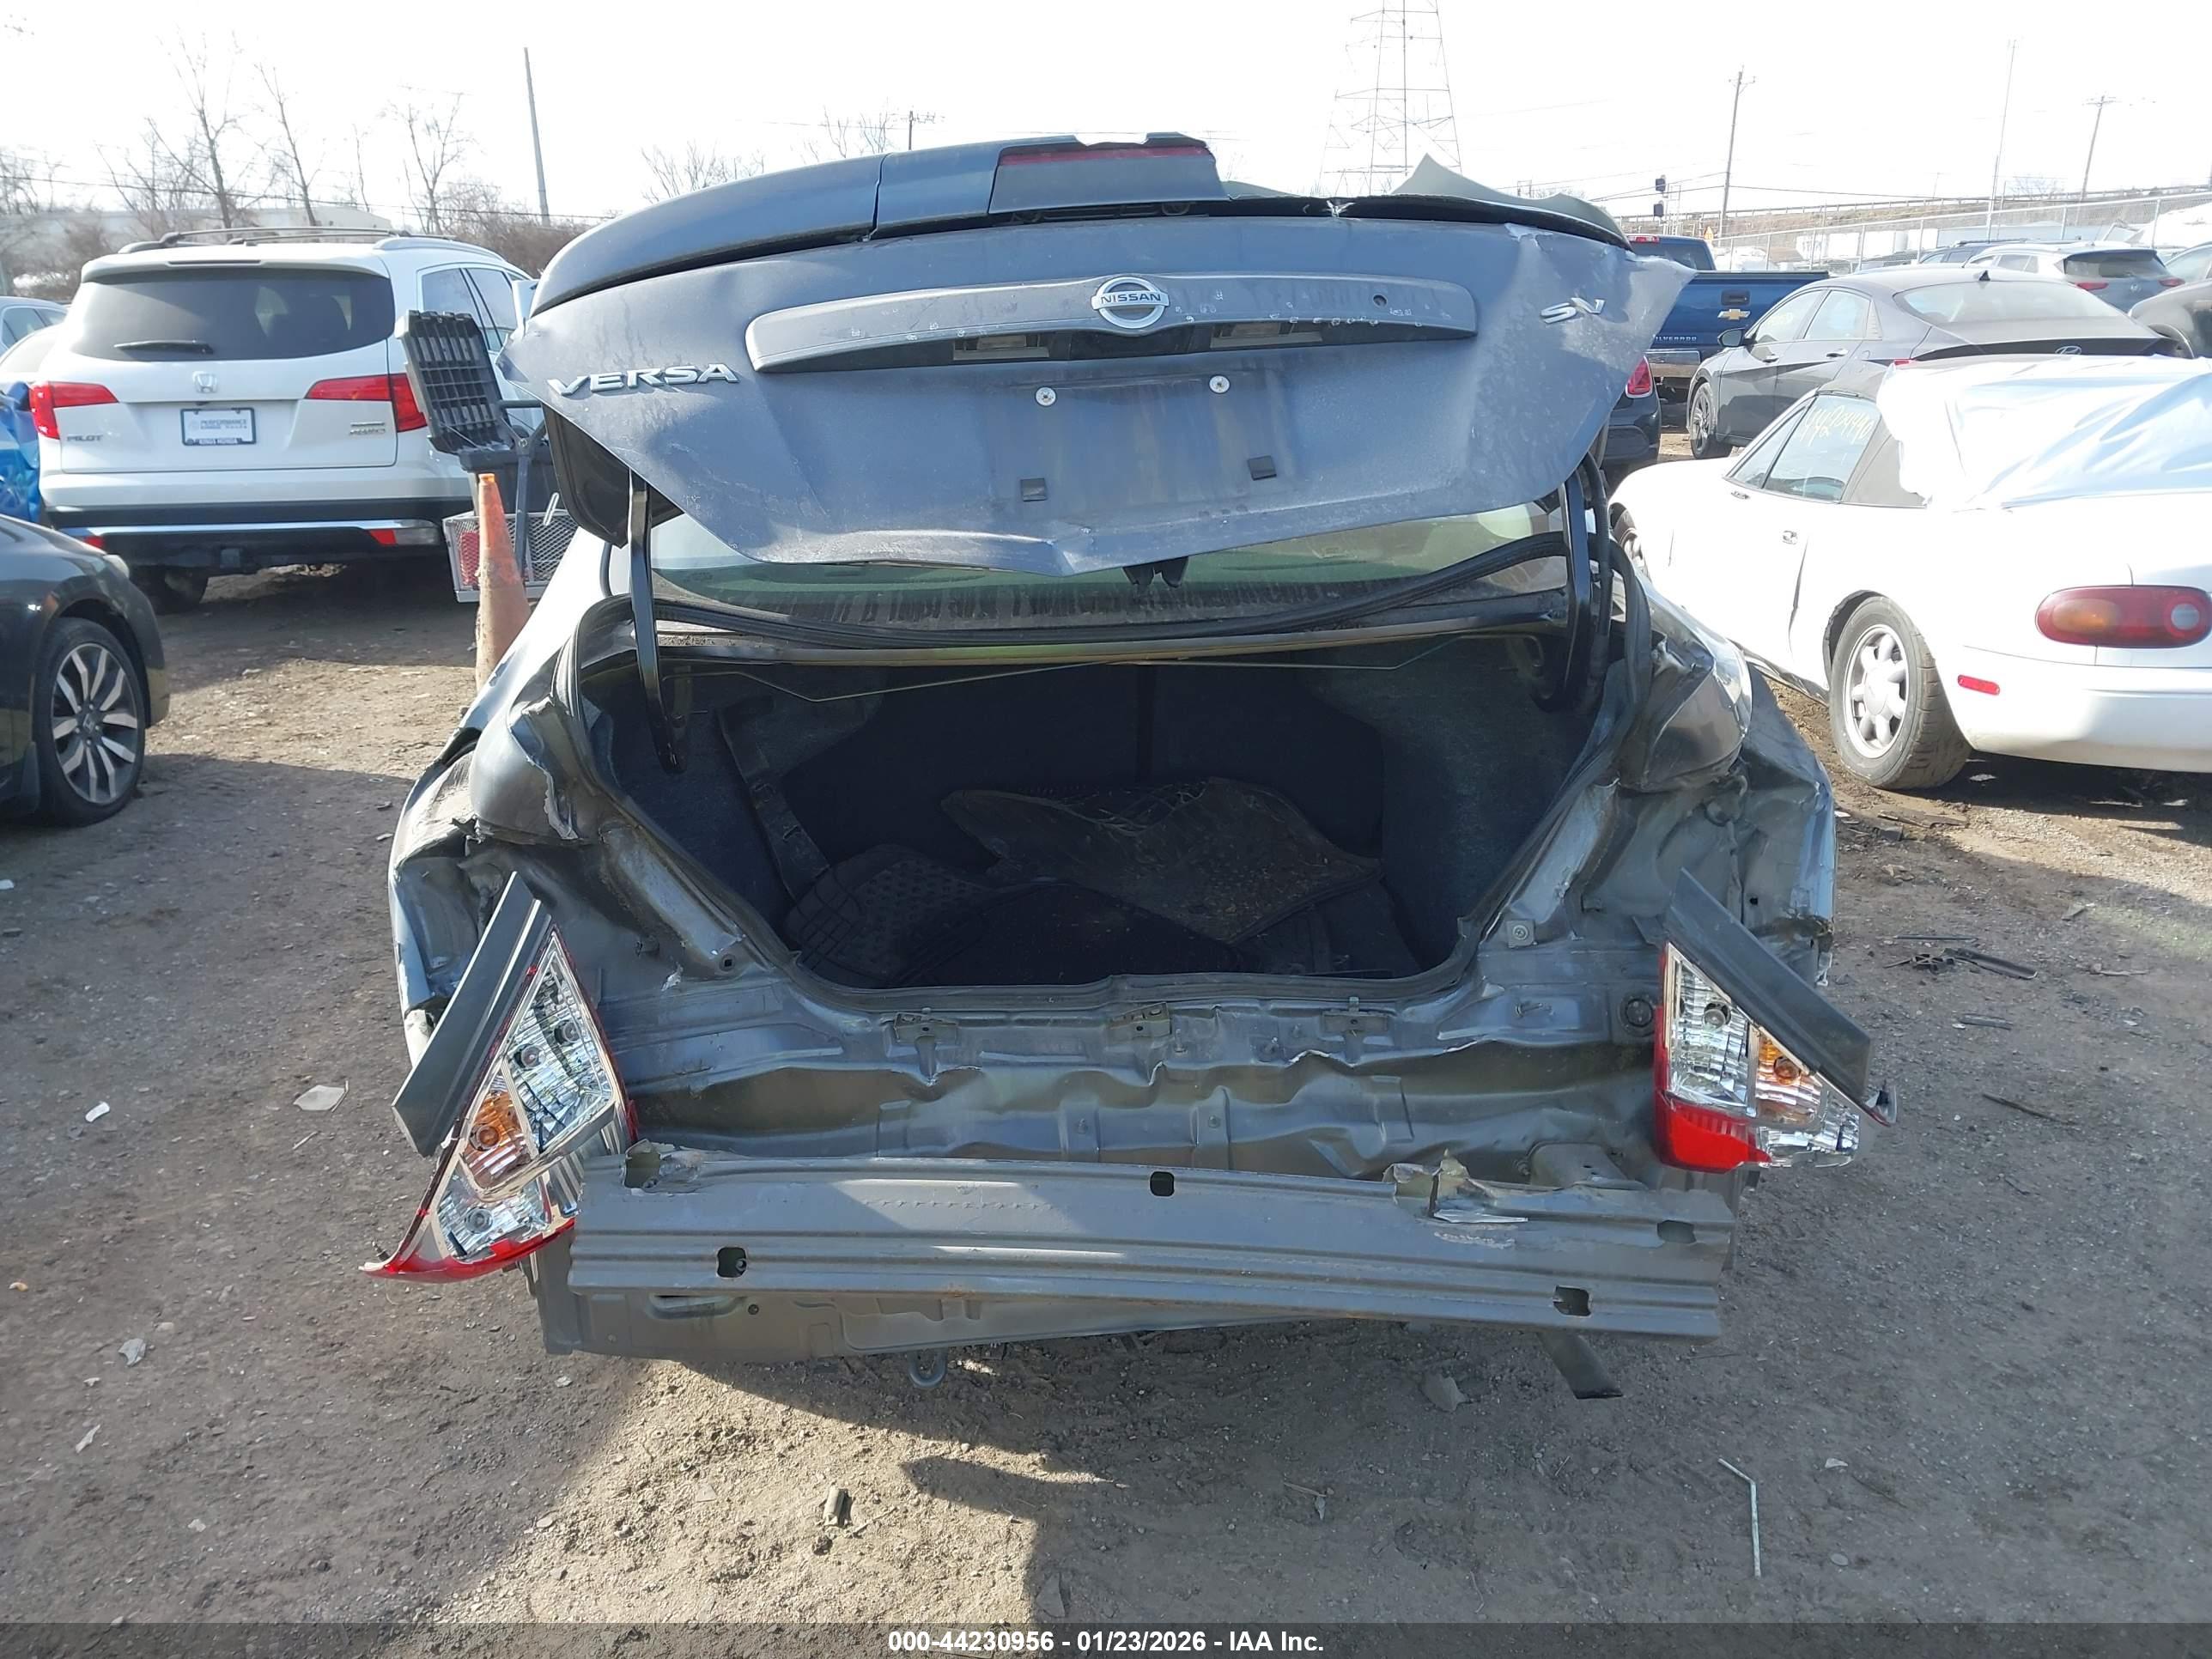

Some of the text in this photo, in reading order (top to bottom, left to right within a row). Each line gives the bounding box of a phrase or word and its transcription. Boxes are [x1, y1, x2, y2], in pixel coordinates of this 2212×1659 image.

[1101, 293, 1161, 304] NISSAN
[1541, 297, 1605, 324] SV
[546, 363, 740, 396] VERSA
